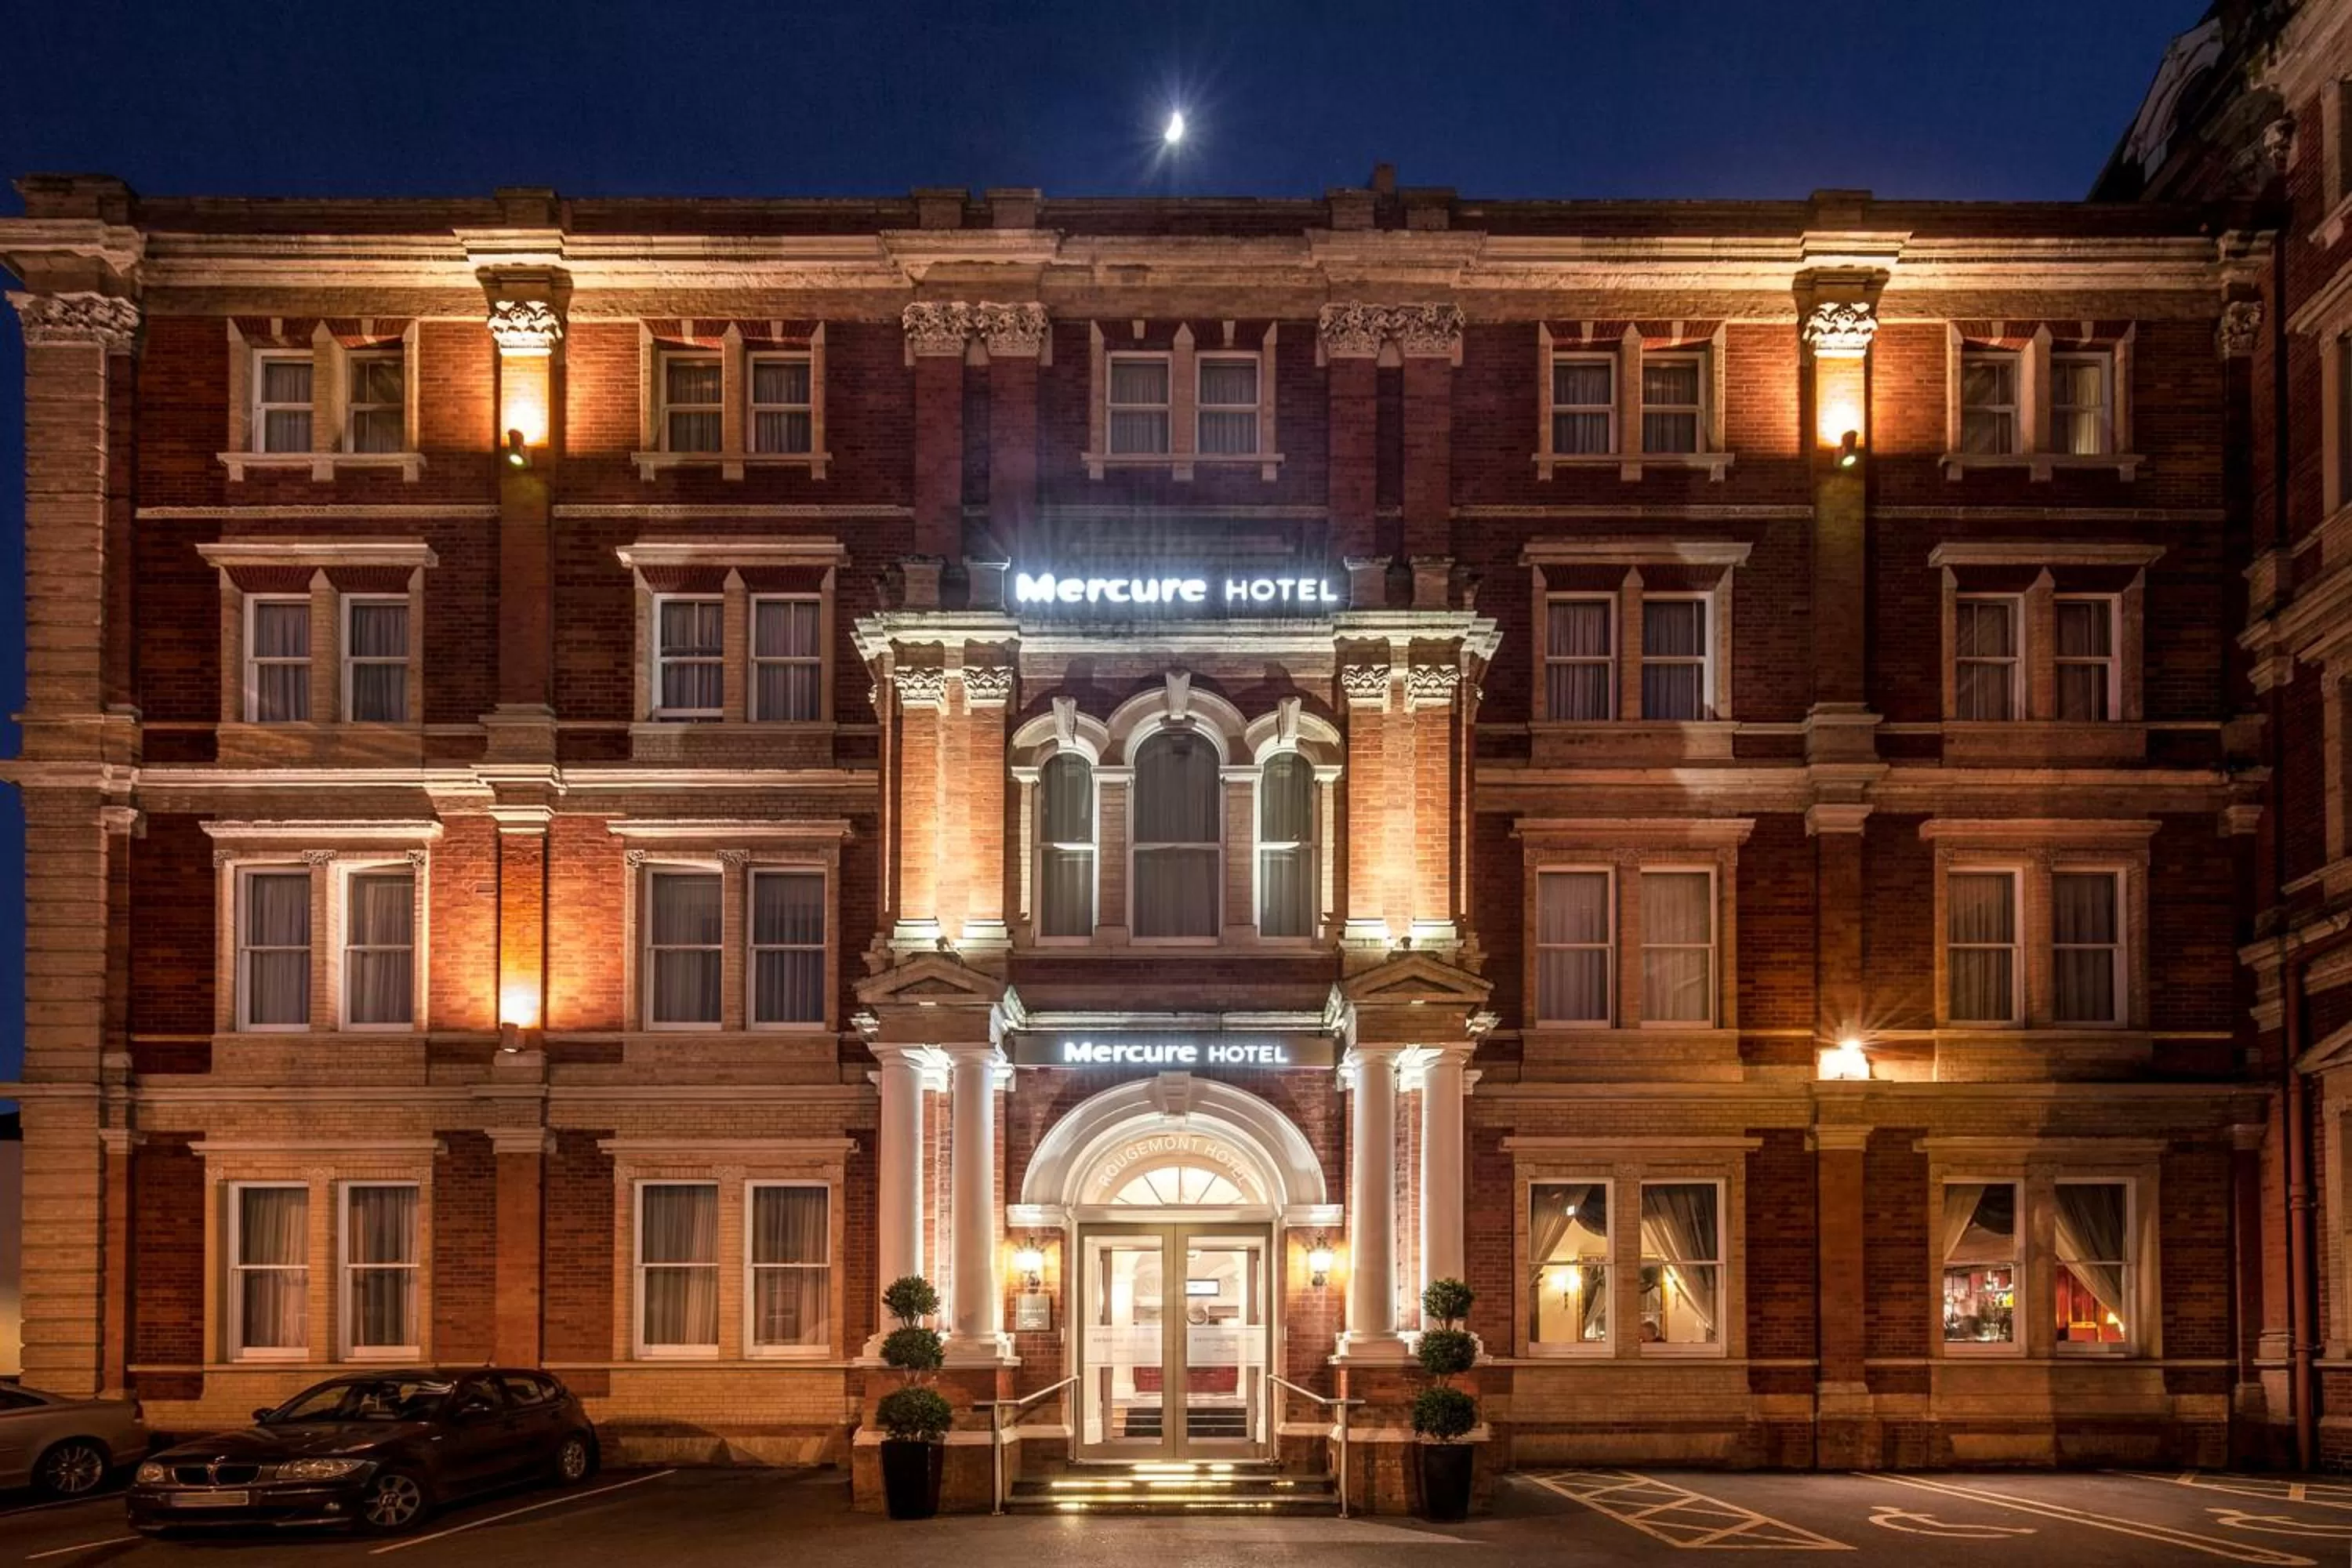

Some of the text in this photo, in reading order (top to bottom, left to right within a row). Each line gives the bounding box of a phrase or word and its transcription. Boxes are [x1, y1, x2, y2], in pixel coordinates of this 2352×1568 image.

[1015, 572, 1338, 603] Mercure HOTEL
[1063, 1041, 1288, 1063] Mercure HOTEL
[1099, 1137, 1245, 1188] ROUGEMONT HOTEL
